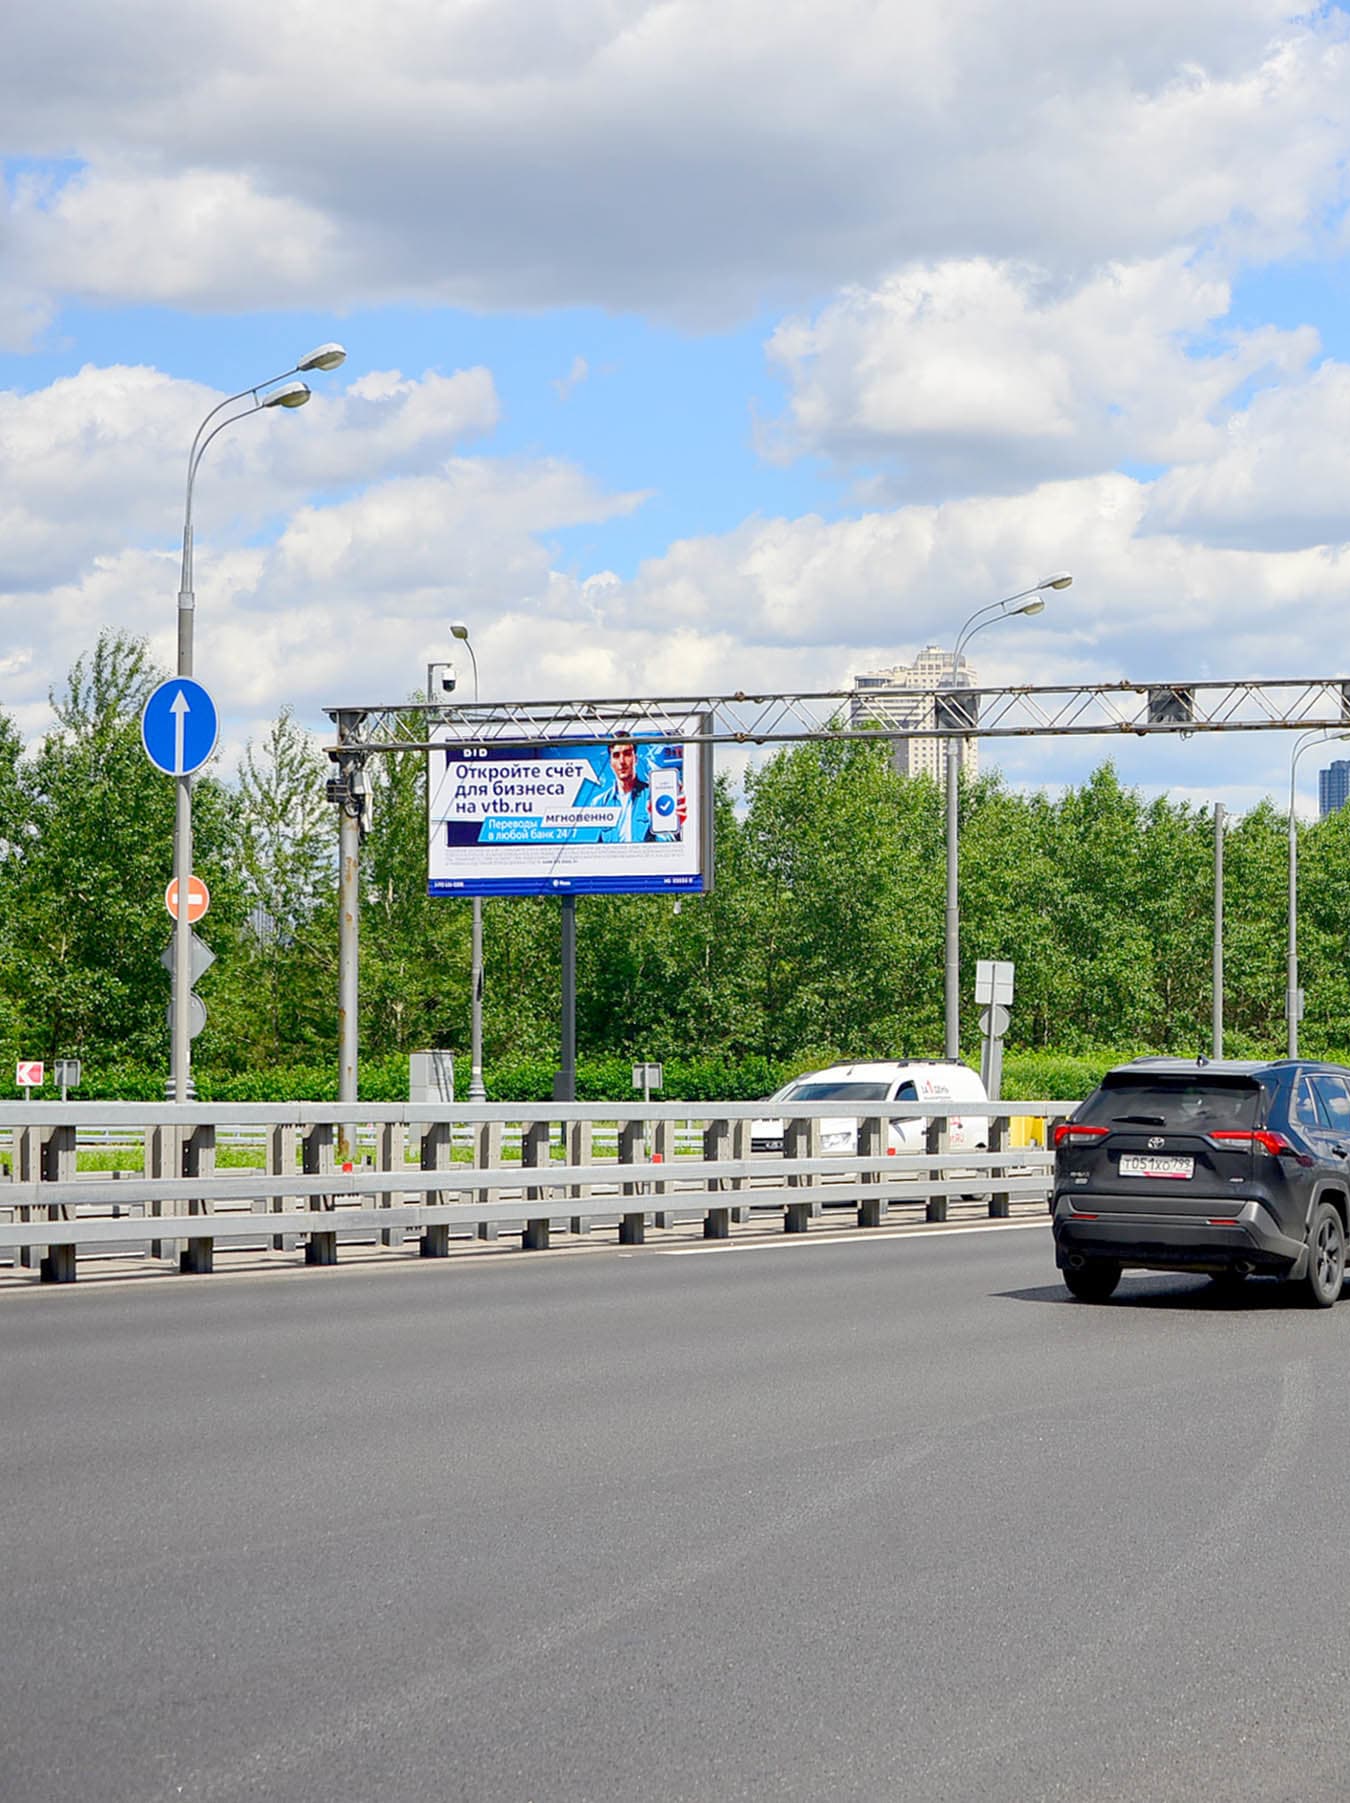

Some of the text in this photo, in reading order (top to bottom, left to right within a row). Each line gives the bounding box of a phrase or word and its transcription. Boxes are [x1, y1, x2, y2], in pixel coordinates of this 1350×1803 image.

[455, 762, 583, 783] Откройте счёт
[455, 780, 565, 799] для бизнеса
[456, 797, 533, 814] на vtb.ru
[488, 818, 538, 831] Переводы
[545, 812, 614, 823] мгновенно
[496, 828, 529, 841] любой
[530, 828, 553, 840] банк
[556, 827, 578, 839] 24/7
